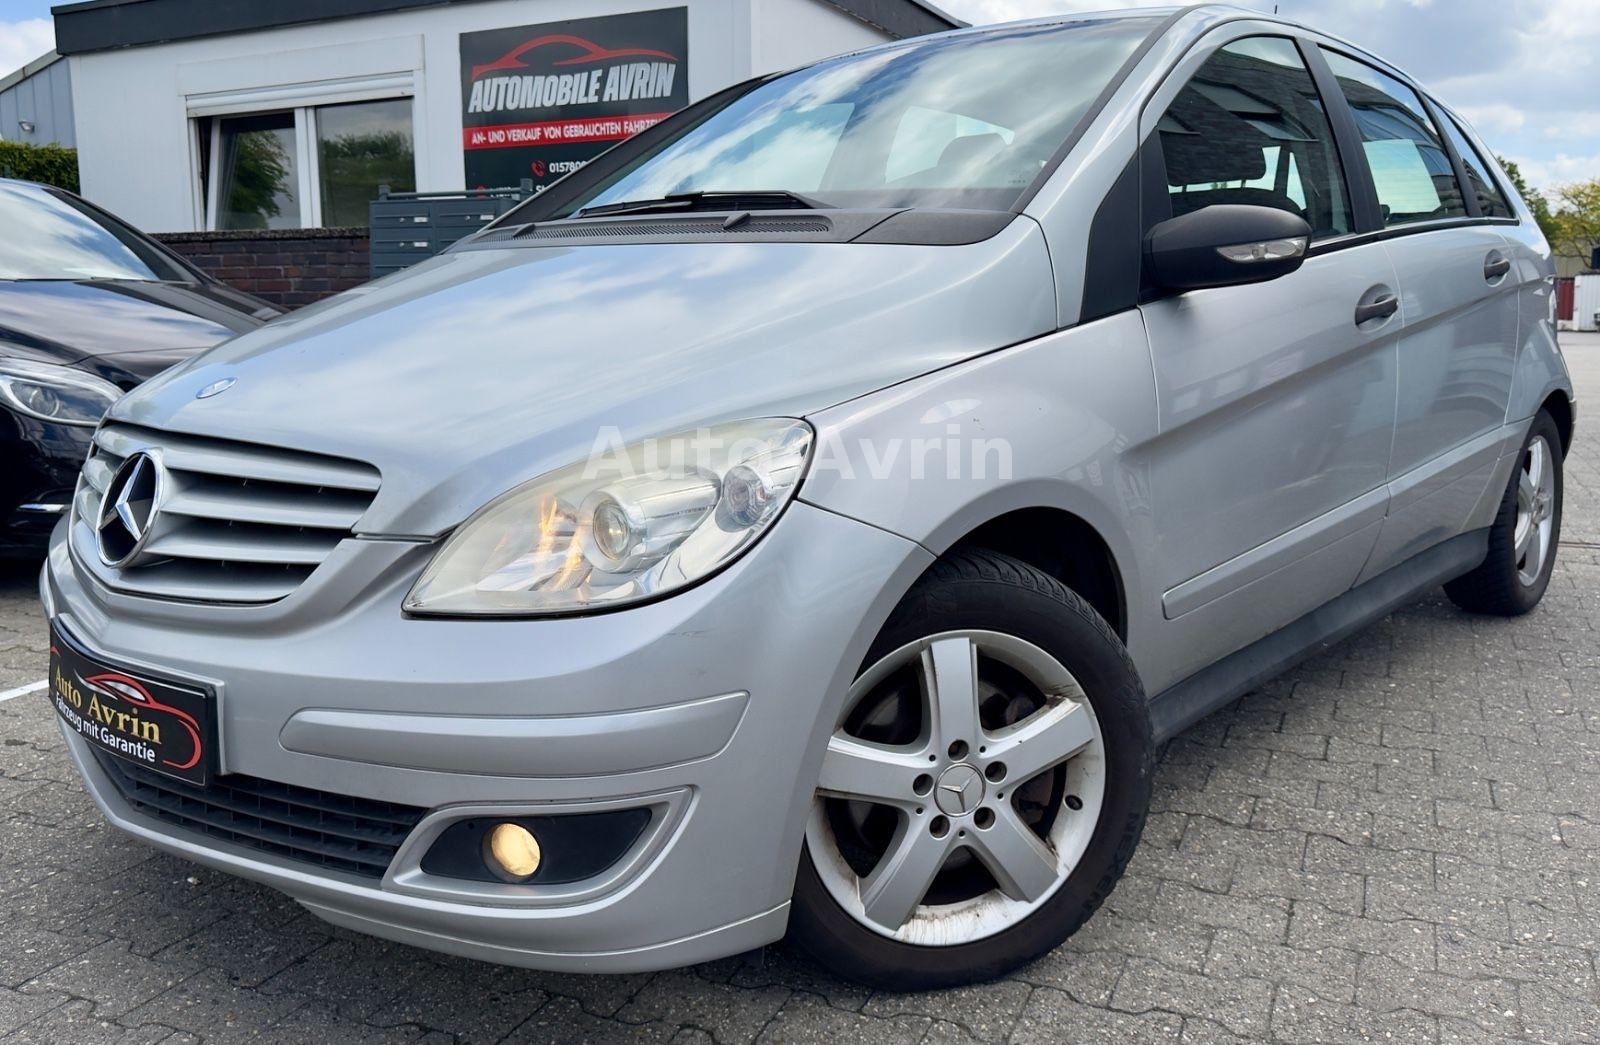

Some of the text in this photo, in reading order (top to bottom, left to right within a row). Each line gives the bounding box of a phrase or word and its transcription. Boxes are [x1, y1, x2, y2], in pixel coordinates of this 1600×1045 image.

[468, 62, 676, 113] AUTOMOBILE AVRIN
[472, 133, 486, 144] AN-
[488, 131, 505, 143] UND
[506, 128, 541, 141] VERKAUF
[543, 126, 562, 138] VON
[563, 121, 621, 137] GEBRAUCHTEN
[55, 664, 162, 745] Auto Avrin
[56, 691, 156, 763] Fahrzeug mit Garantie
